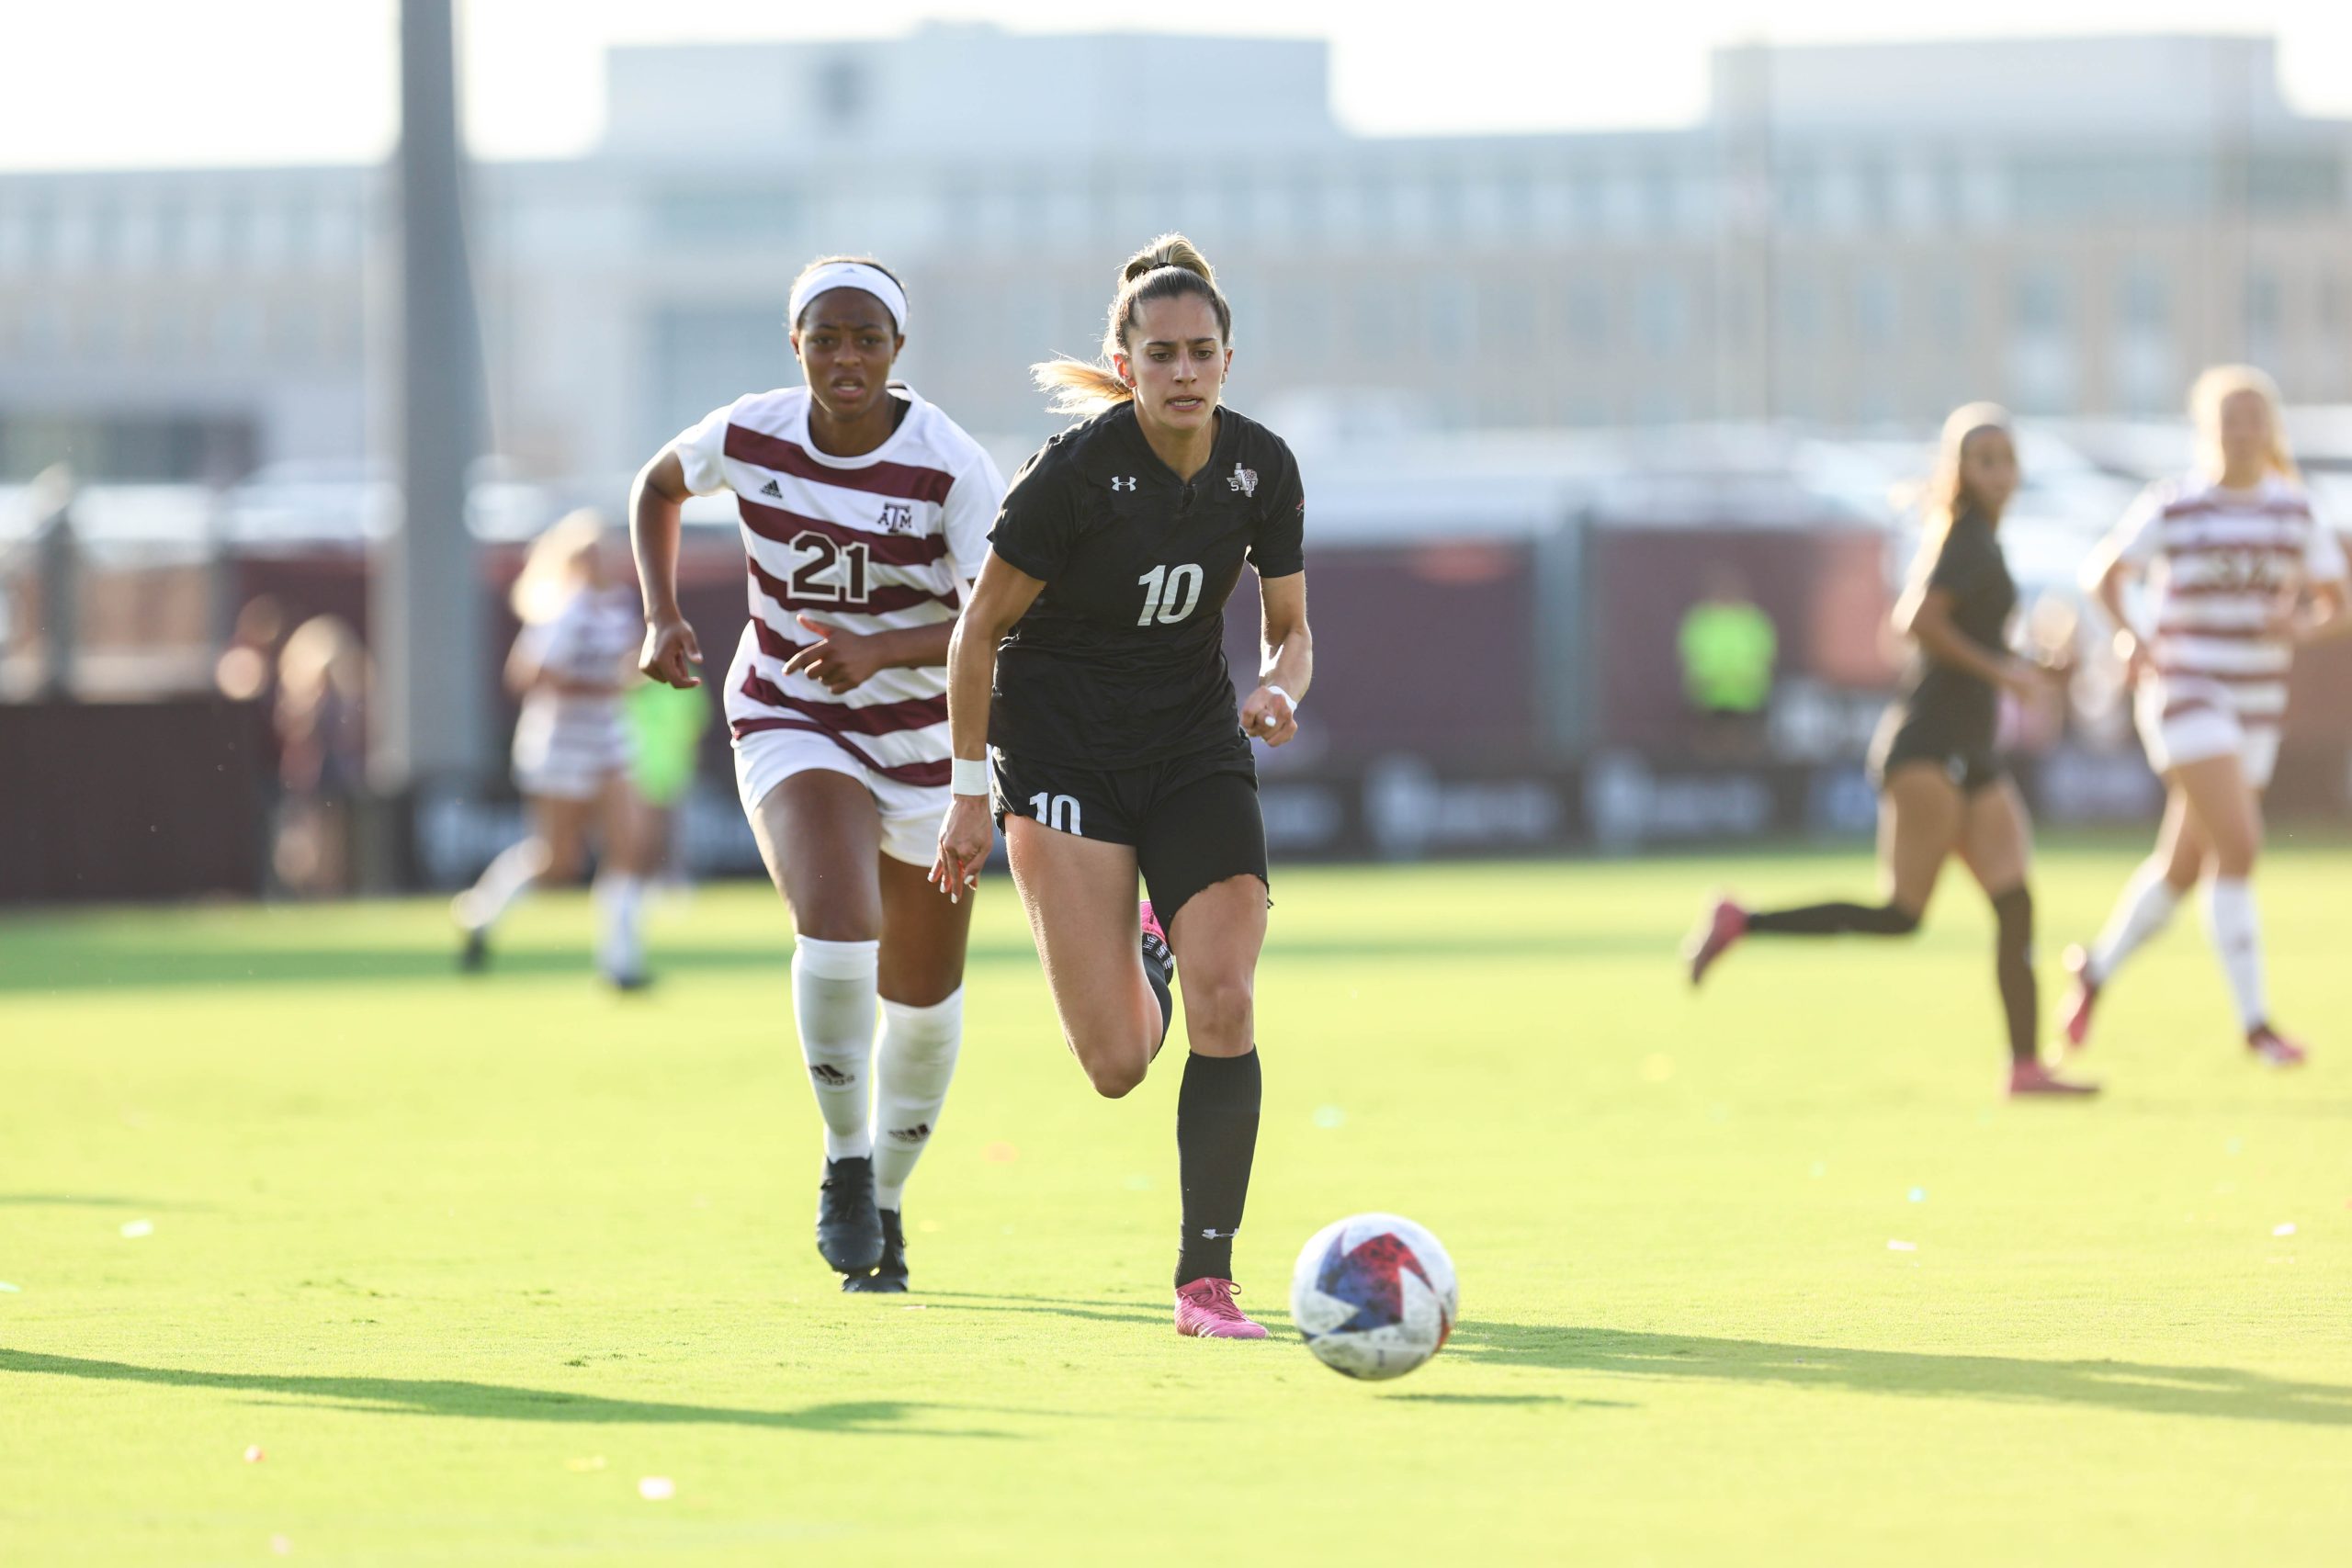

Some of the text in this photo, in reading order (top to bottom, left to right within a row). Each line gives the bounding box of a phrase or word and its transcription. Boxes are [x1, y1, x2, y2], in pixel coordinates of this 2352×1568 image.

[786, 530, 869, 604] 21
[1137, 563, 1204, 626] 10
[1029, 792, 1082, 837] 10
